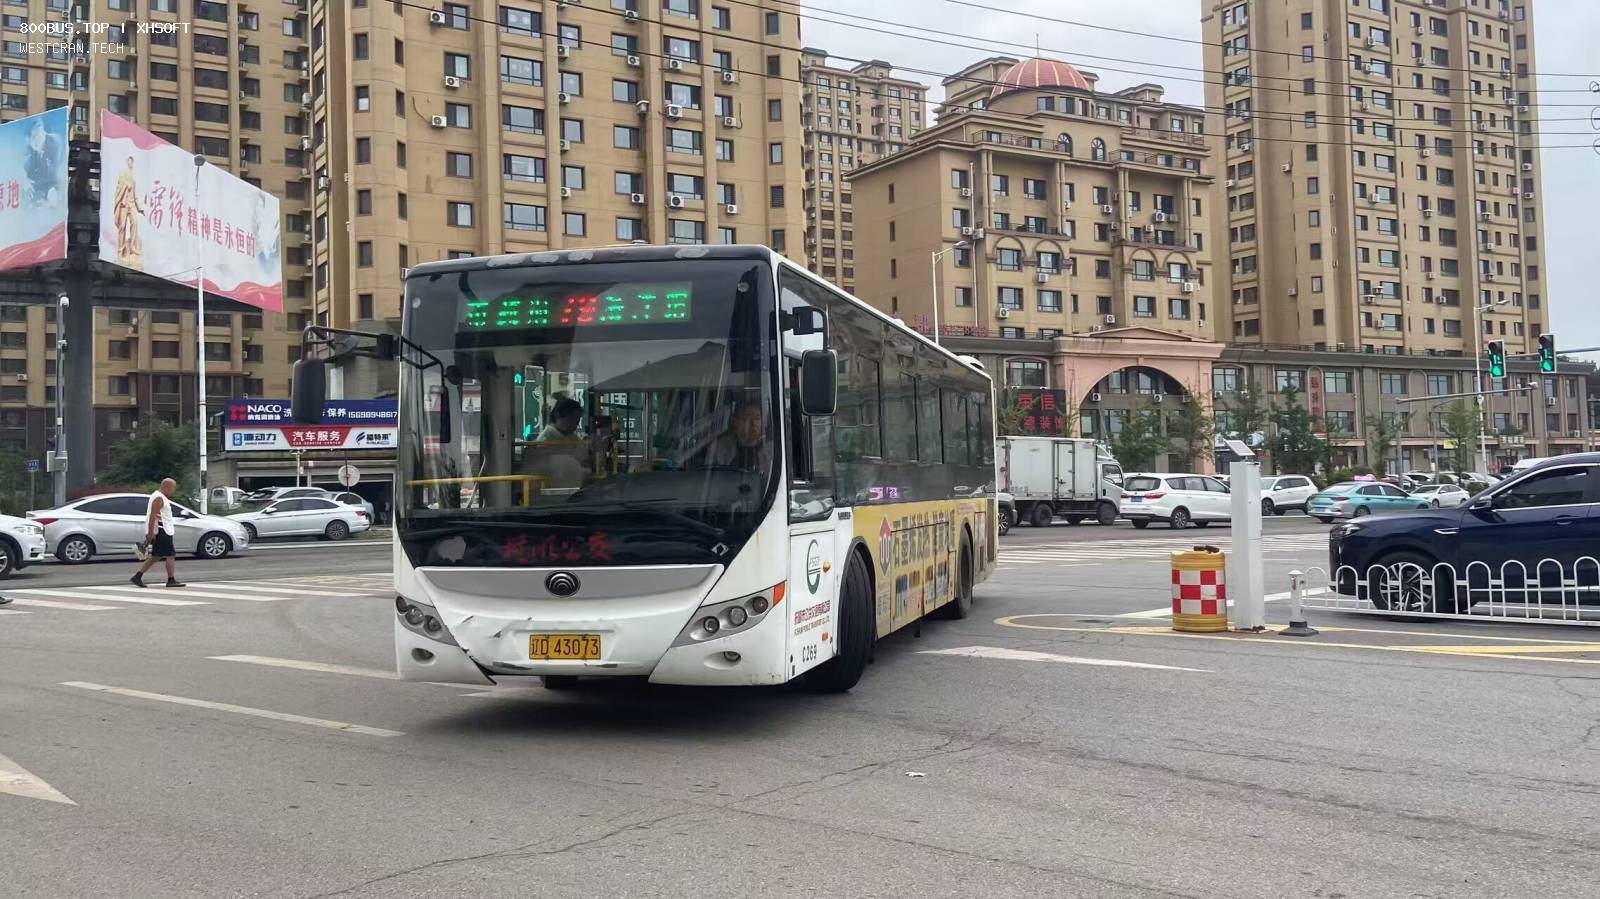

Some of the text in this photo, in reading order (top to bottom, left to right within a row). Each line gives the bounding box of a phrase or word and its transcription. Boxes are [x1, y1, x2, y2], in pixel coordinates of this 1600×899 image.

[0, 178, 20, 209] 地
[144, 179, 256, 259] 雷锋精神是永恒的
[247, 404, 282, 413] NACO
[327, 407, 347, 418] 保养
[292, 431, 341, 442] 汽车服务
